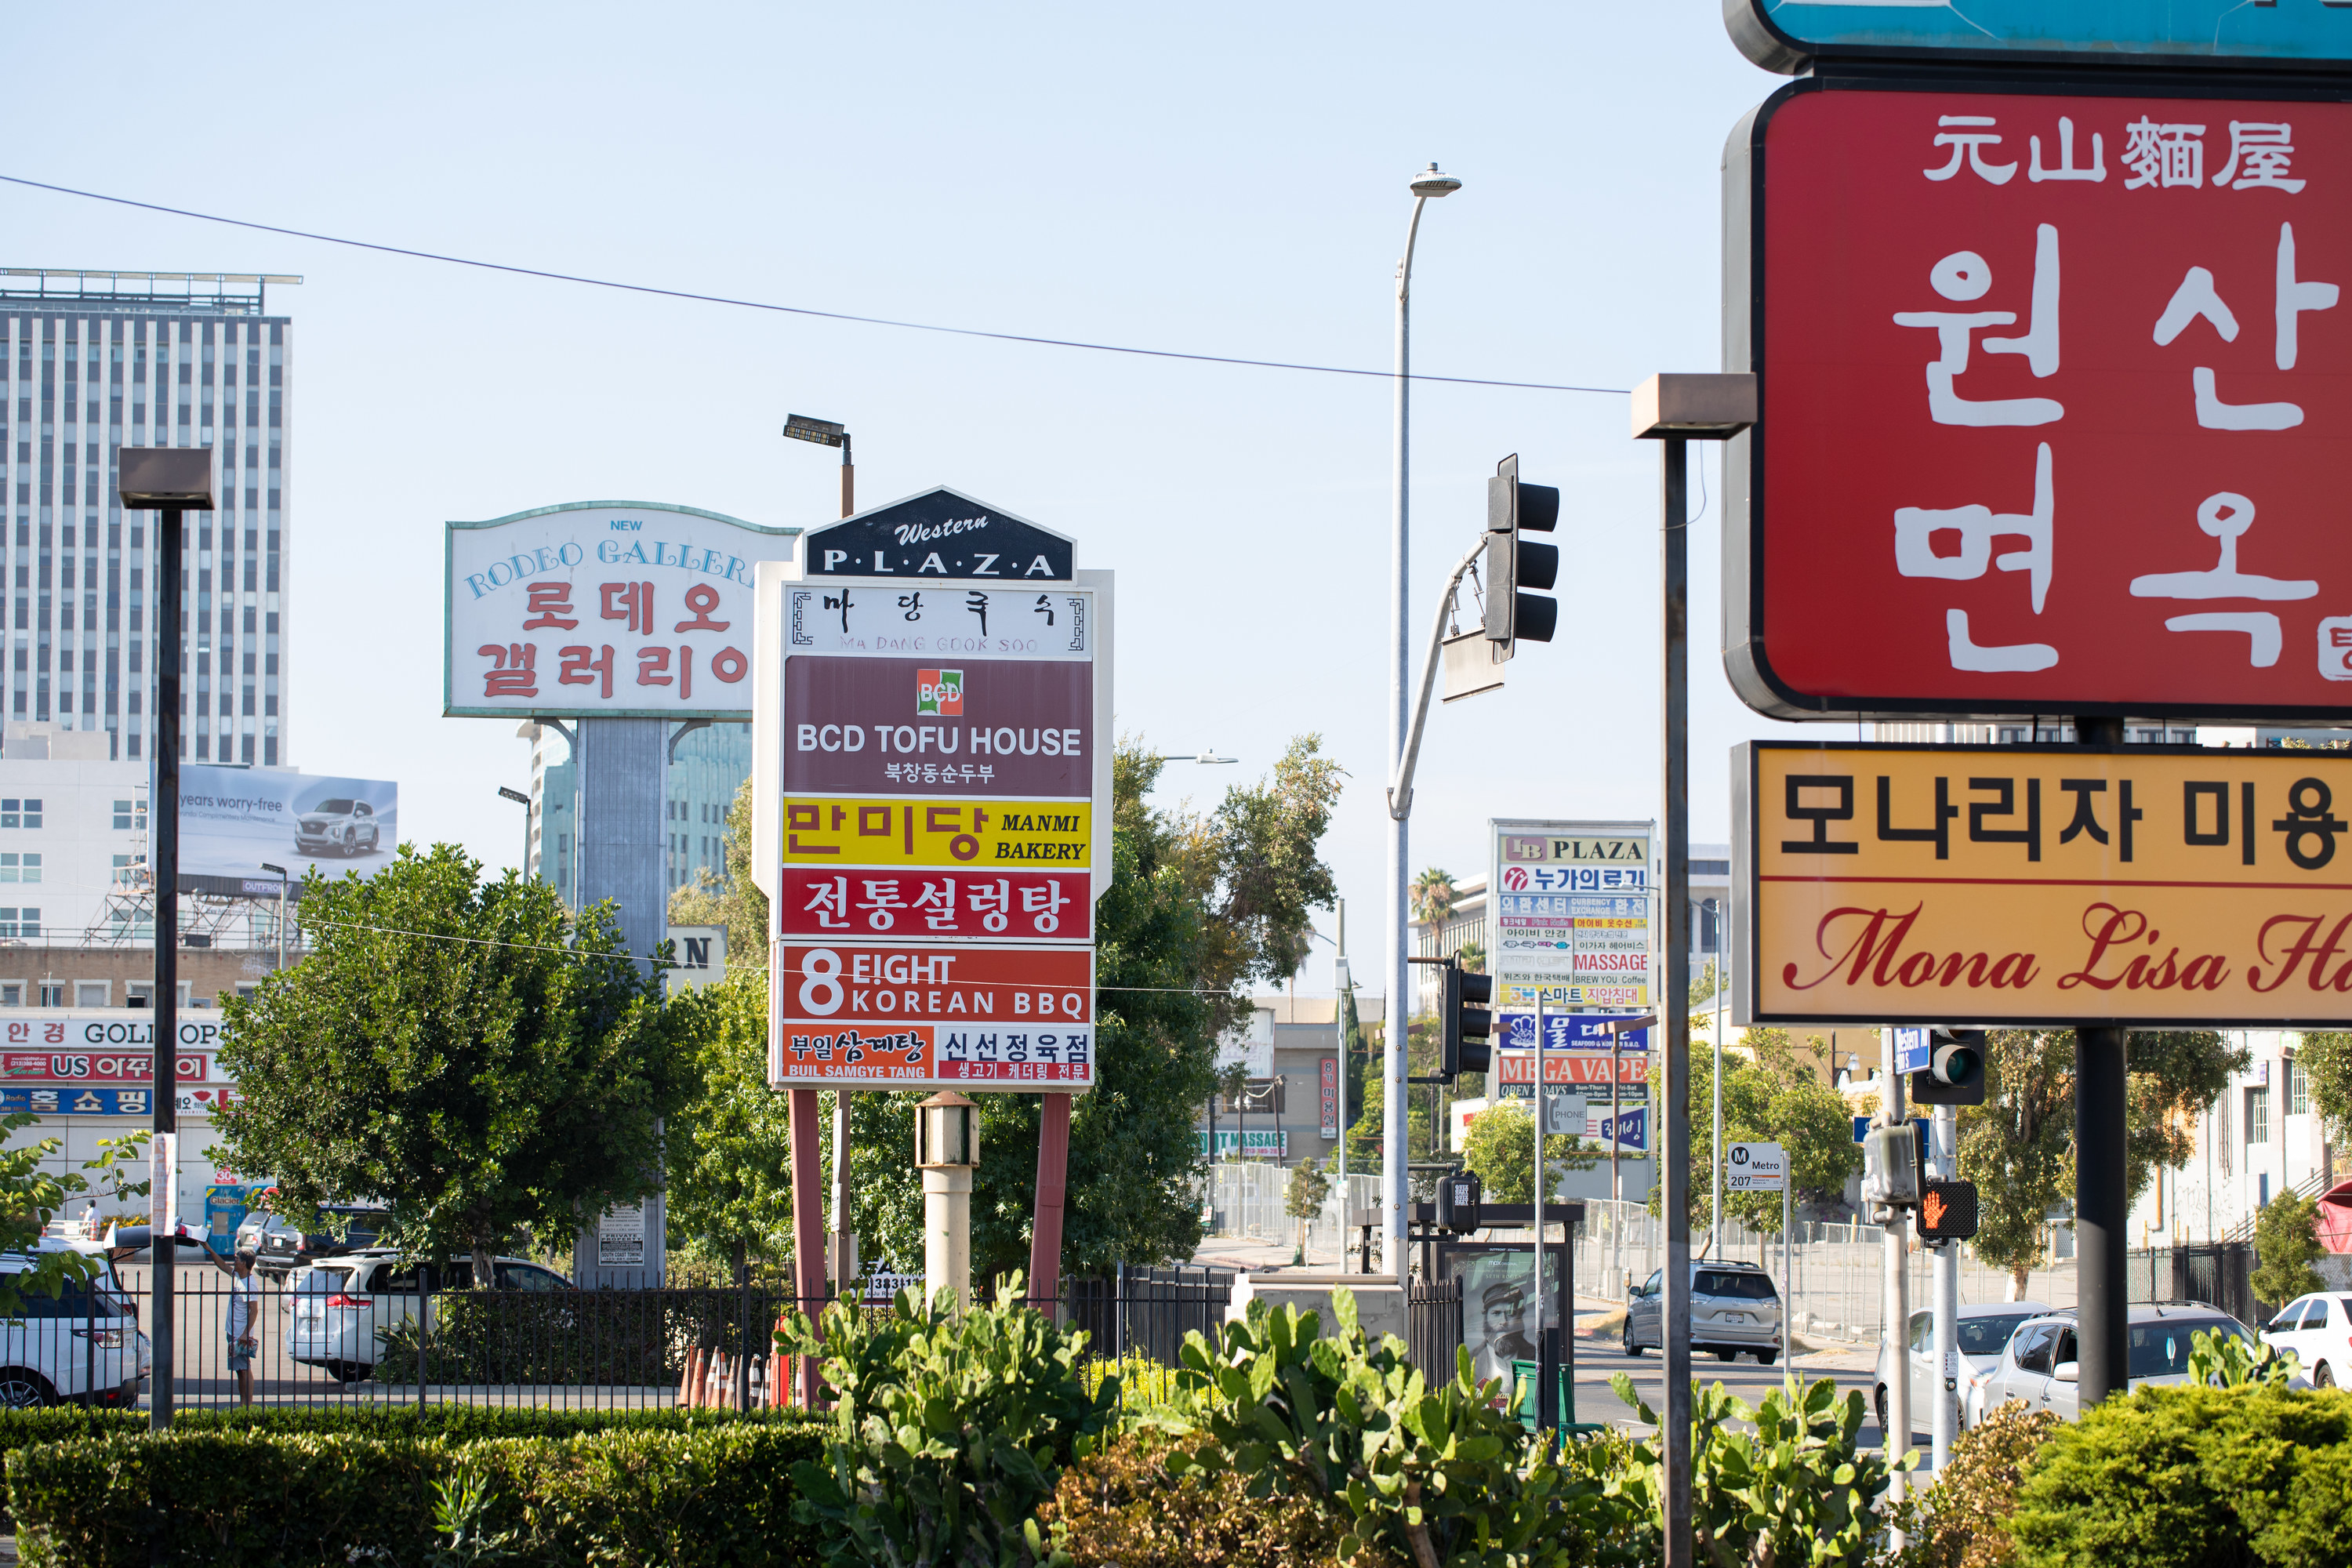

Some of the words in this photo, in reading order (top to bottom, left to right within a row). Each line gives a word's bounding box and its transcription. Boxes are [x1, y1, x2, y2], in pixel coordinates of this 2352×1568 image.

[1922, 115, 2307, 194] 元山麵屋
[1893, 221, 2340, 431] 원산
[611, 521, 642, 531] NEW
[895, 514, 989, 546] Western
[1894, 442, 2319, 672] 면옥
[464, 543, 583, 601] RODEO
[523, 581, 730, 635] 로데오
[840, 637, 866, 650] MA
[876, 637, 925, 651] DANG
[937, 637, 987, 652] GOOK
[920, 682, 960, 702] BCD
[797, 724, 865, 752] BCD
[875, 725, 957, 753] TOFU
[971, 728, 1080, 756] HOUSE
[884, 763, 995, 783] 북창동순두부
[180, 795, 213, 807] years
[217, 797, 282, 811] worry-free
[1002, 815, 1080, 832] MANMI
[1781, 775, 2143, 862] 모나리자
[788, 804, 989, 861] 만미당
[995, 843, 1085, 860] BAKERY
[1553, 841, 1643, 859] PLAZA
[804, 877, 1070, 933] 전통설렁탕
[1577, 919, 1602, 927] 아이비
[1545, 929, 1566, 938] 안경
[1783, 900, 2040, 991] Mona
[2057, 902, 2230, 991] Lisa
[1574, 955, 1647, 970] MASSAGE
[799, 949, 844, 1015] 8
[853, 990, 993, 1013] KOREAN
[1014, 993, 1082, 1019] BBQ
[1587, 988, 1637, 1004] 지압침대
[946, 1033, 1088, 1063] 신선정육점
[1896, 1029, 1918, 1052] Western
[53, 1055, 89, 1077] US
[1905, 1052, 1909, 1069] S
[789, 1065, 821, 1076] BUIL
[826, 1065, 884, 1077] SAMGYE
[888, 1066, 925, 1078] TANG
[958, 1062, 997, 1079] 생고기
[1058, 1064, 1084, 1080] 전문
[30, 1091, 146, 1113] 홈쇼핑
[1734, 1150, 1746, 1162] M
[1752, 1161, 1779, 1170] Metro
[1731, 1177, 1751, 1185] 207
